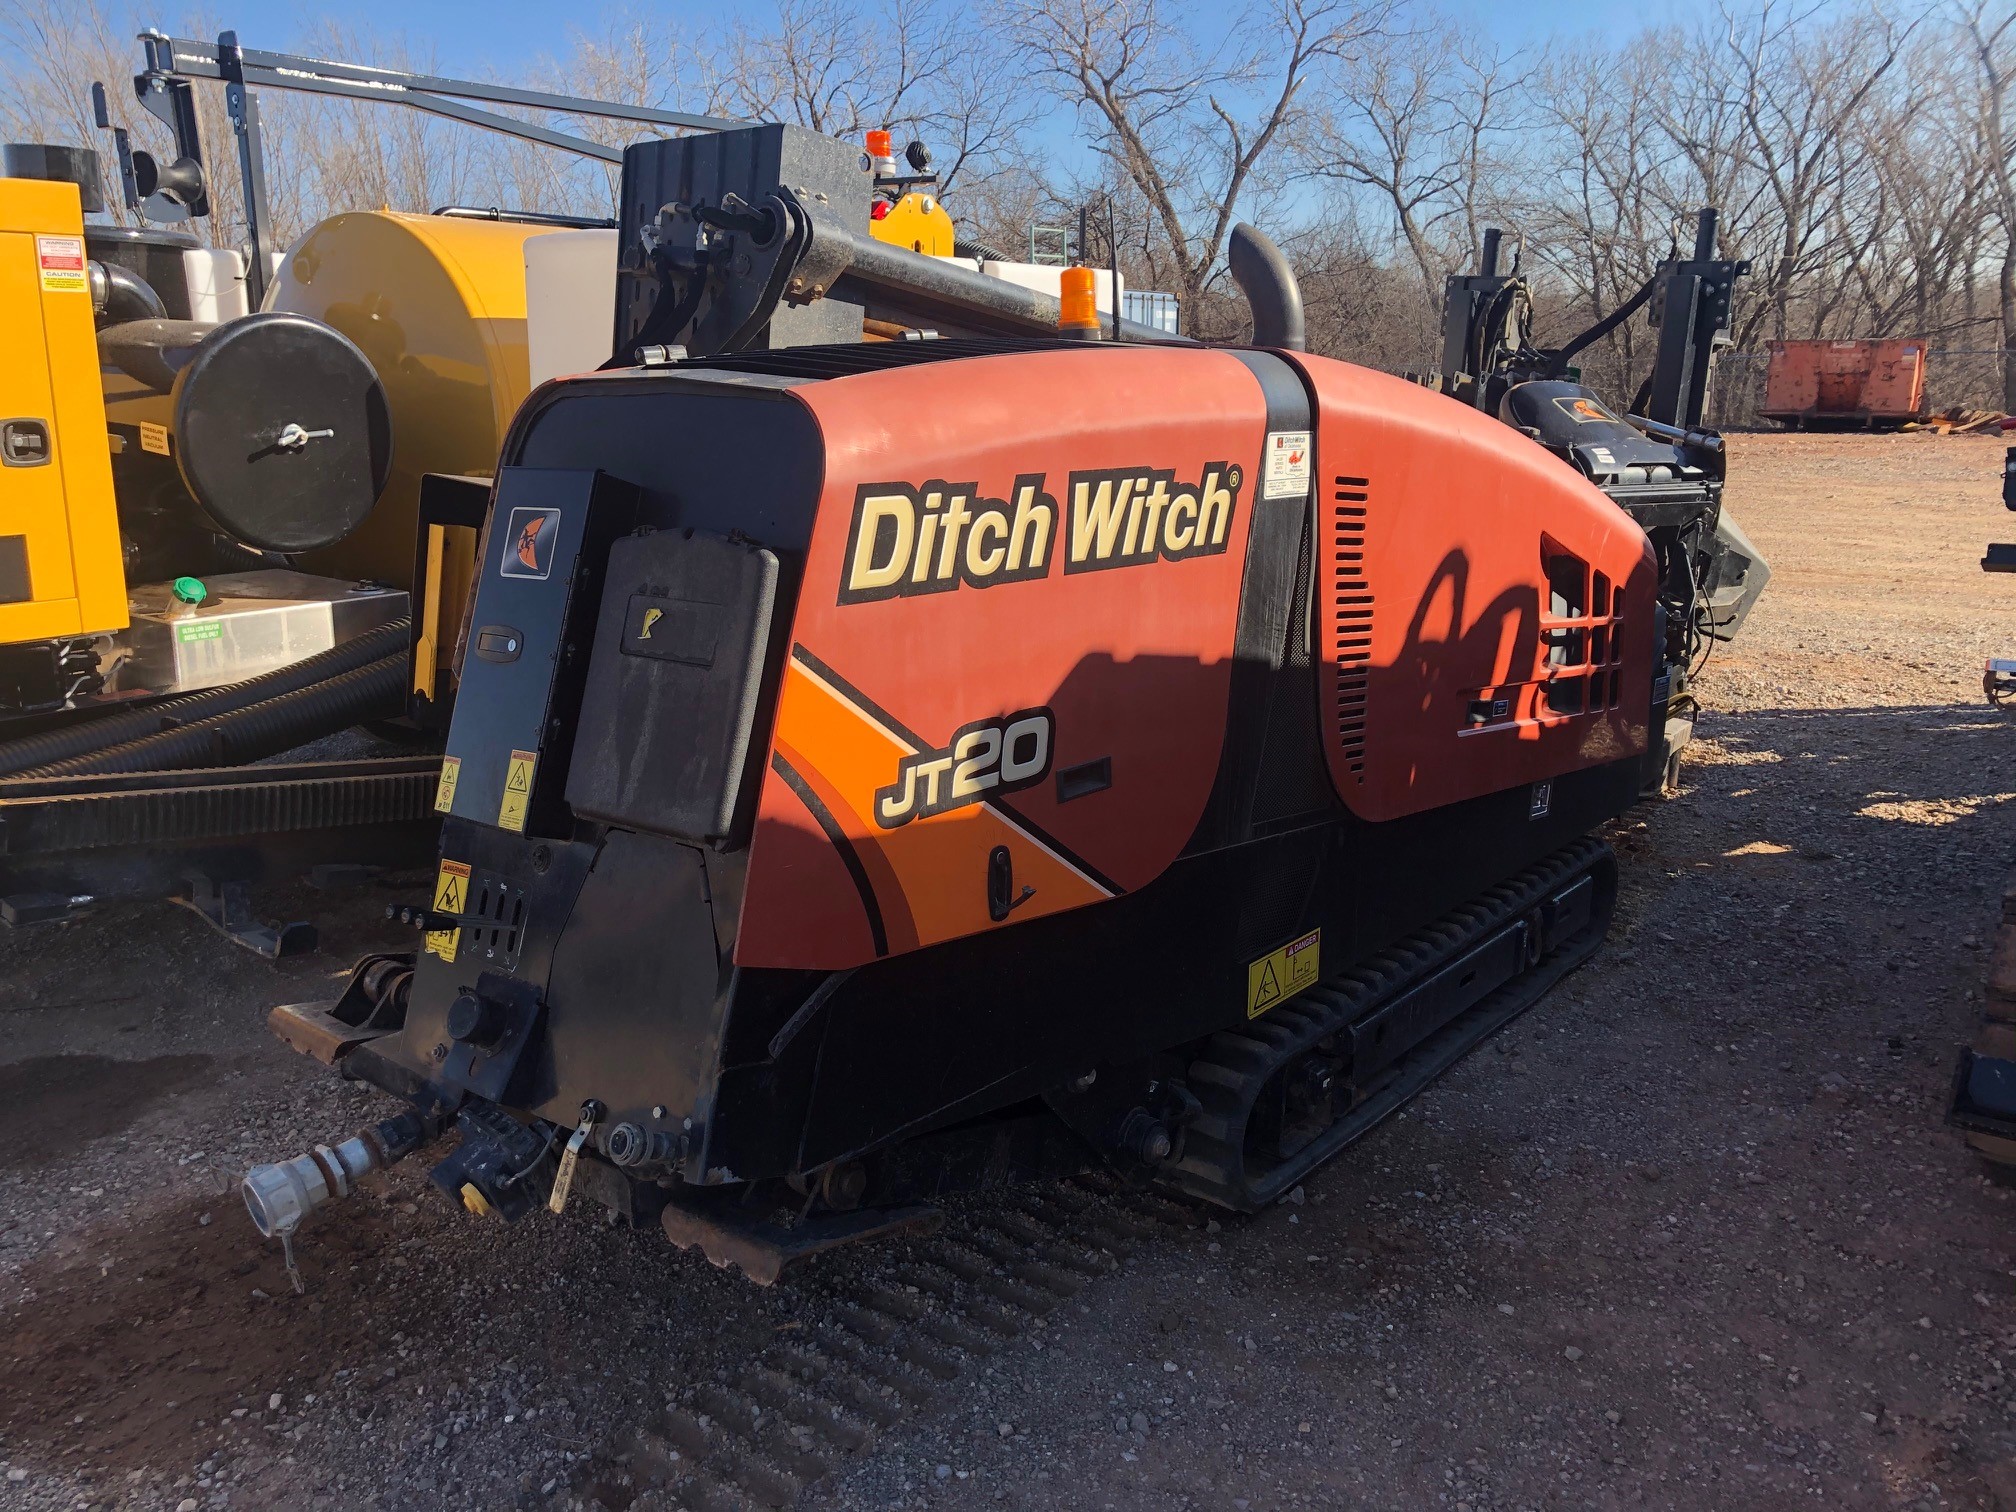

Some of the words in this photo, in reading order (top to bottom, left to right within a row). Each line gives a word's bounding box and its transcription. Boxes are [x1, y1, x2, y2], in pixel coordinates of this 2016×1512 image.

[848, 484, 1052, 591] Ditch
[881, 716, 1050, 818] JT20
[447, 864, 469, 876] WARNING
[1294, 934, 1317, 953] DANGER
